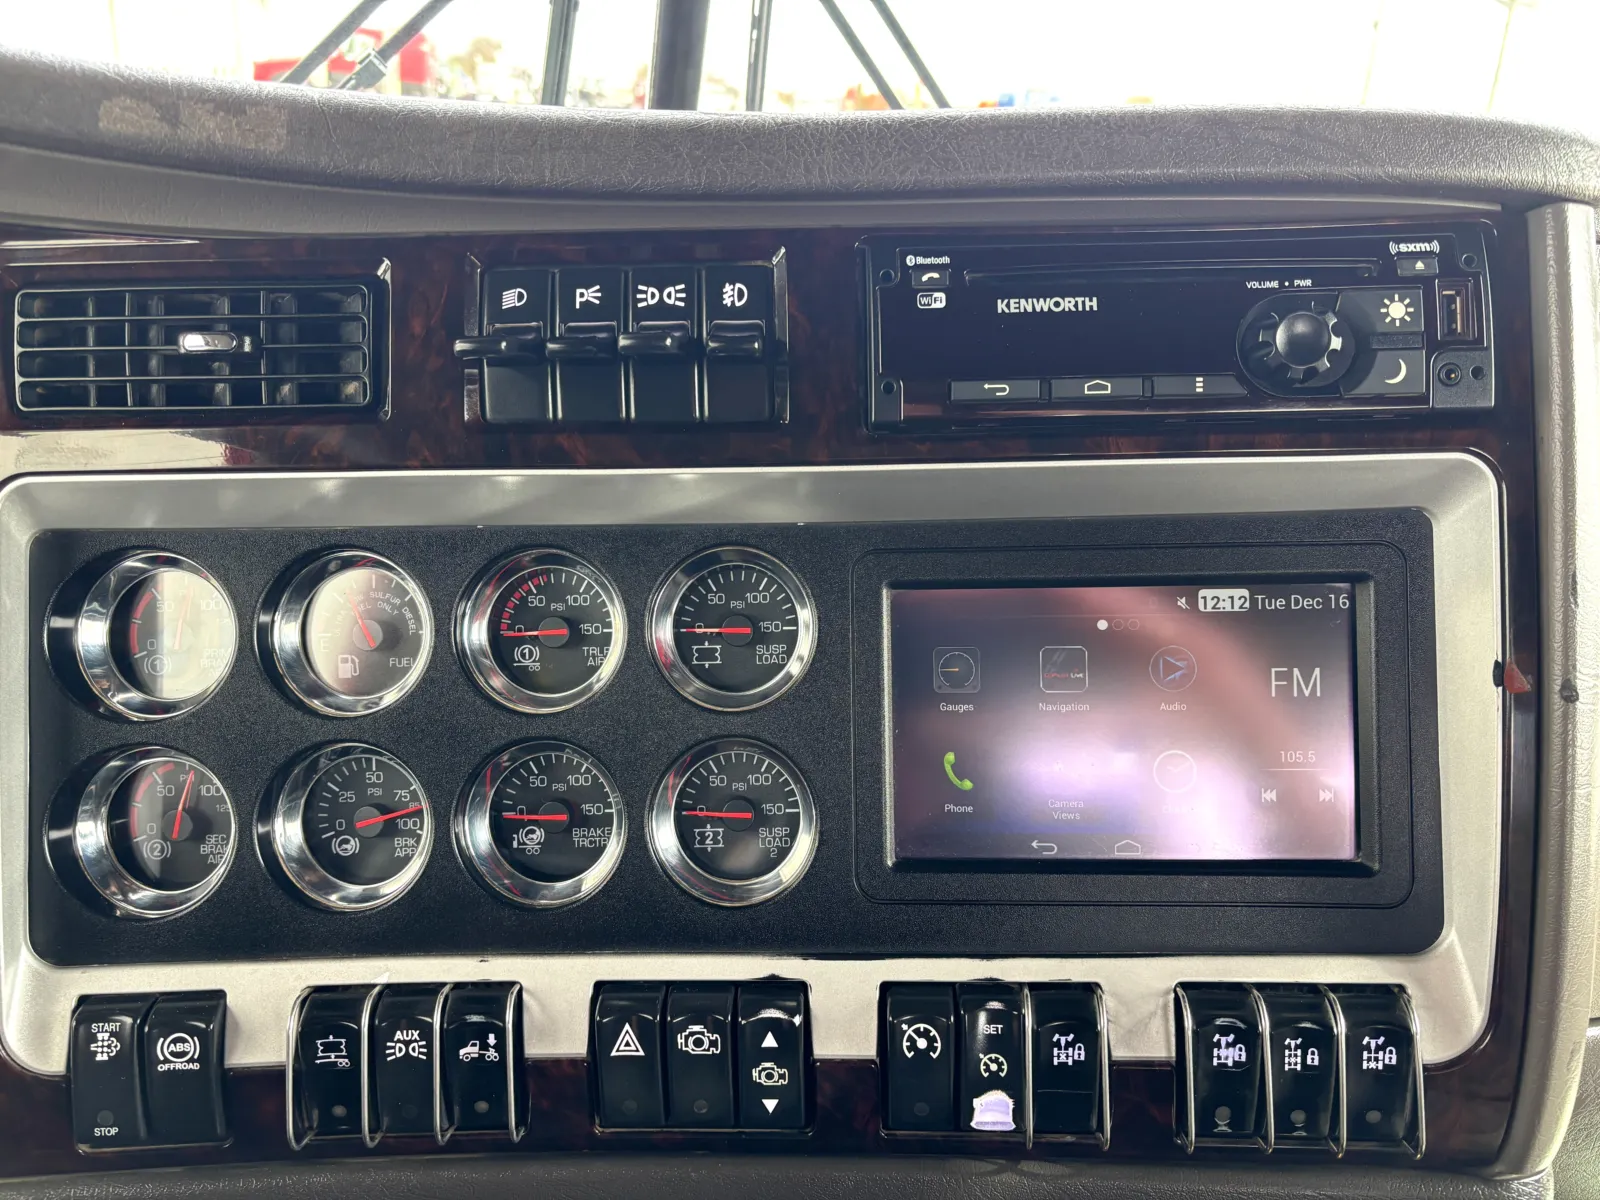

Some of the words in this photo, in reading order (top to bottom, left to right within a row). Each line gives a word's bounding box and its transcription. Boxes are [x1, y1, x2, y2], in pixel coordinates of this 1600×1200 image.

[1398, 242, 1431, 253] sxm
[916, 256, 950, 265] Bluetooth
[1246, 280, 1279, 289] VOLUME
[1294, 279, 1312, 288] PWR
[997, 297, 1098, 313] KENWORTH
[528, 596, 545, 606] 50
[565, 594, 590, 606] 100
[708, 593, 725, 604] 50
[745, 592, 770, 604] 100
[1200, 595, 1248, 610] 12:12
[1254, 595, 1286, 610] Tue
[1290, 595, 1323, 609] Dec
[1329, 594, 1349, 609] 16
[156, 600, 174, 612] 50
[377, 601, 399, 615] ONLY
[551, 603, 566, 611] PSI
[730, 601, 745, 609] PSI
[369, 592, 401, 606] SULFUR
[402, 606, 417, 635] DIESEL
[579, 623, 602, 635] 150
[758, 621, 782, 633] 150
[756, 644, 787, 654] SUSP
[756, 654, 787, 664] LOAD
[1271, 667, 1321, 697] FM
[939, 702, 974, 713] Gauges
[1039, 702, 1090, 713] Navigation
[1159, 702, 1187, 711] Audio
[1280, 750, 1316, 763] 105.5
[365, 771, 384, 783] 50
[529, 776, 547, 787] 50
[567, 774, 592, 786] 100
[709, 775, 727, 786] 50
[747, 774, 772, 785] 100
[156, 785, 175, 797] 50
[199, 785, 222, 796] 100
[367, 788, 383, 796] PSI
[552, 783, 567, 791] PSI
[732, 783, 747, 791] PSI
[339, 791, 356, 802] 25
[393, 790, 410, 801] 75
[944, 804, 974, 813] Phone
[1048, 799, 1084, 808] Camera
[580, 804, 603, 815] 150
[761, 804, 784, 815] 150
[1052, 811, 1081, 820] Views
[147, 823, 157, 834] 0
[336, 819, 345, 831] 0
[395, 818, 420, 830] 100
[572, 827, 611, 838] BRAKE
[758, 827, 790, 837] SUSP
[205, 835, 227, 845] SEC
[394, 838, 417, 847] BRK
[573, 838, 609, 848] TRCTR
[758, 838, 790, 847] LOAD
[394, 848, 417, 857] APP
[770, 848, 777, 858] 2
[91, 1023, 121, 1033] START
[983, 1024, 1003, 1035] SET
[394, 1030, 420, 1040] AUX
[168, 1043, 191, 1052] ABS
[157, 1063, 200, 1072] OFFROAD
[94, 1127, 119, 1137] STOP
